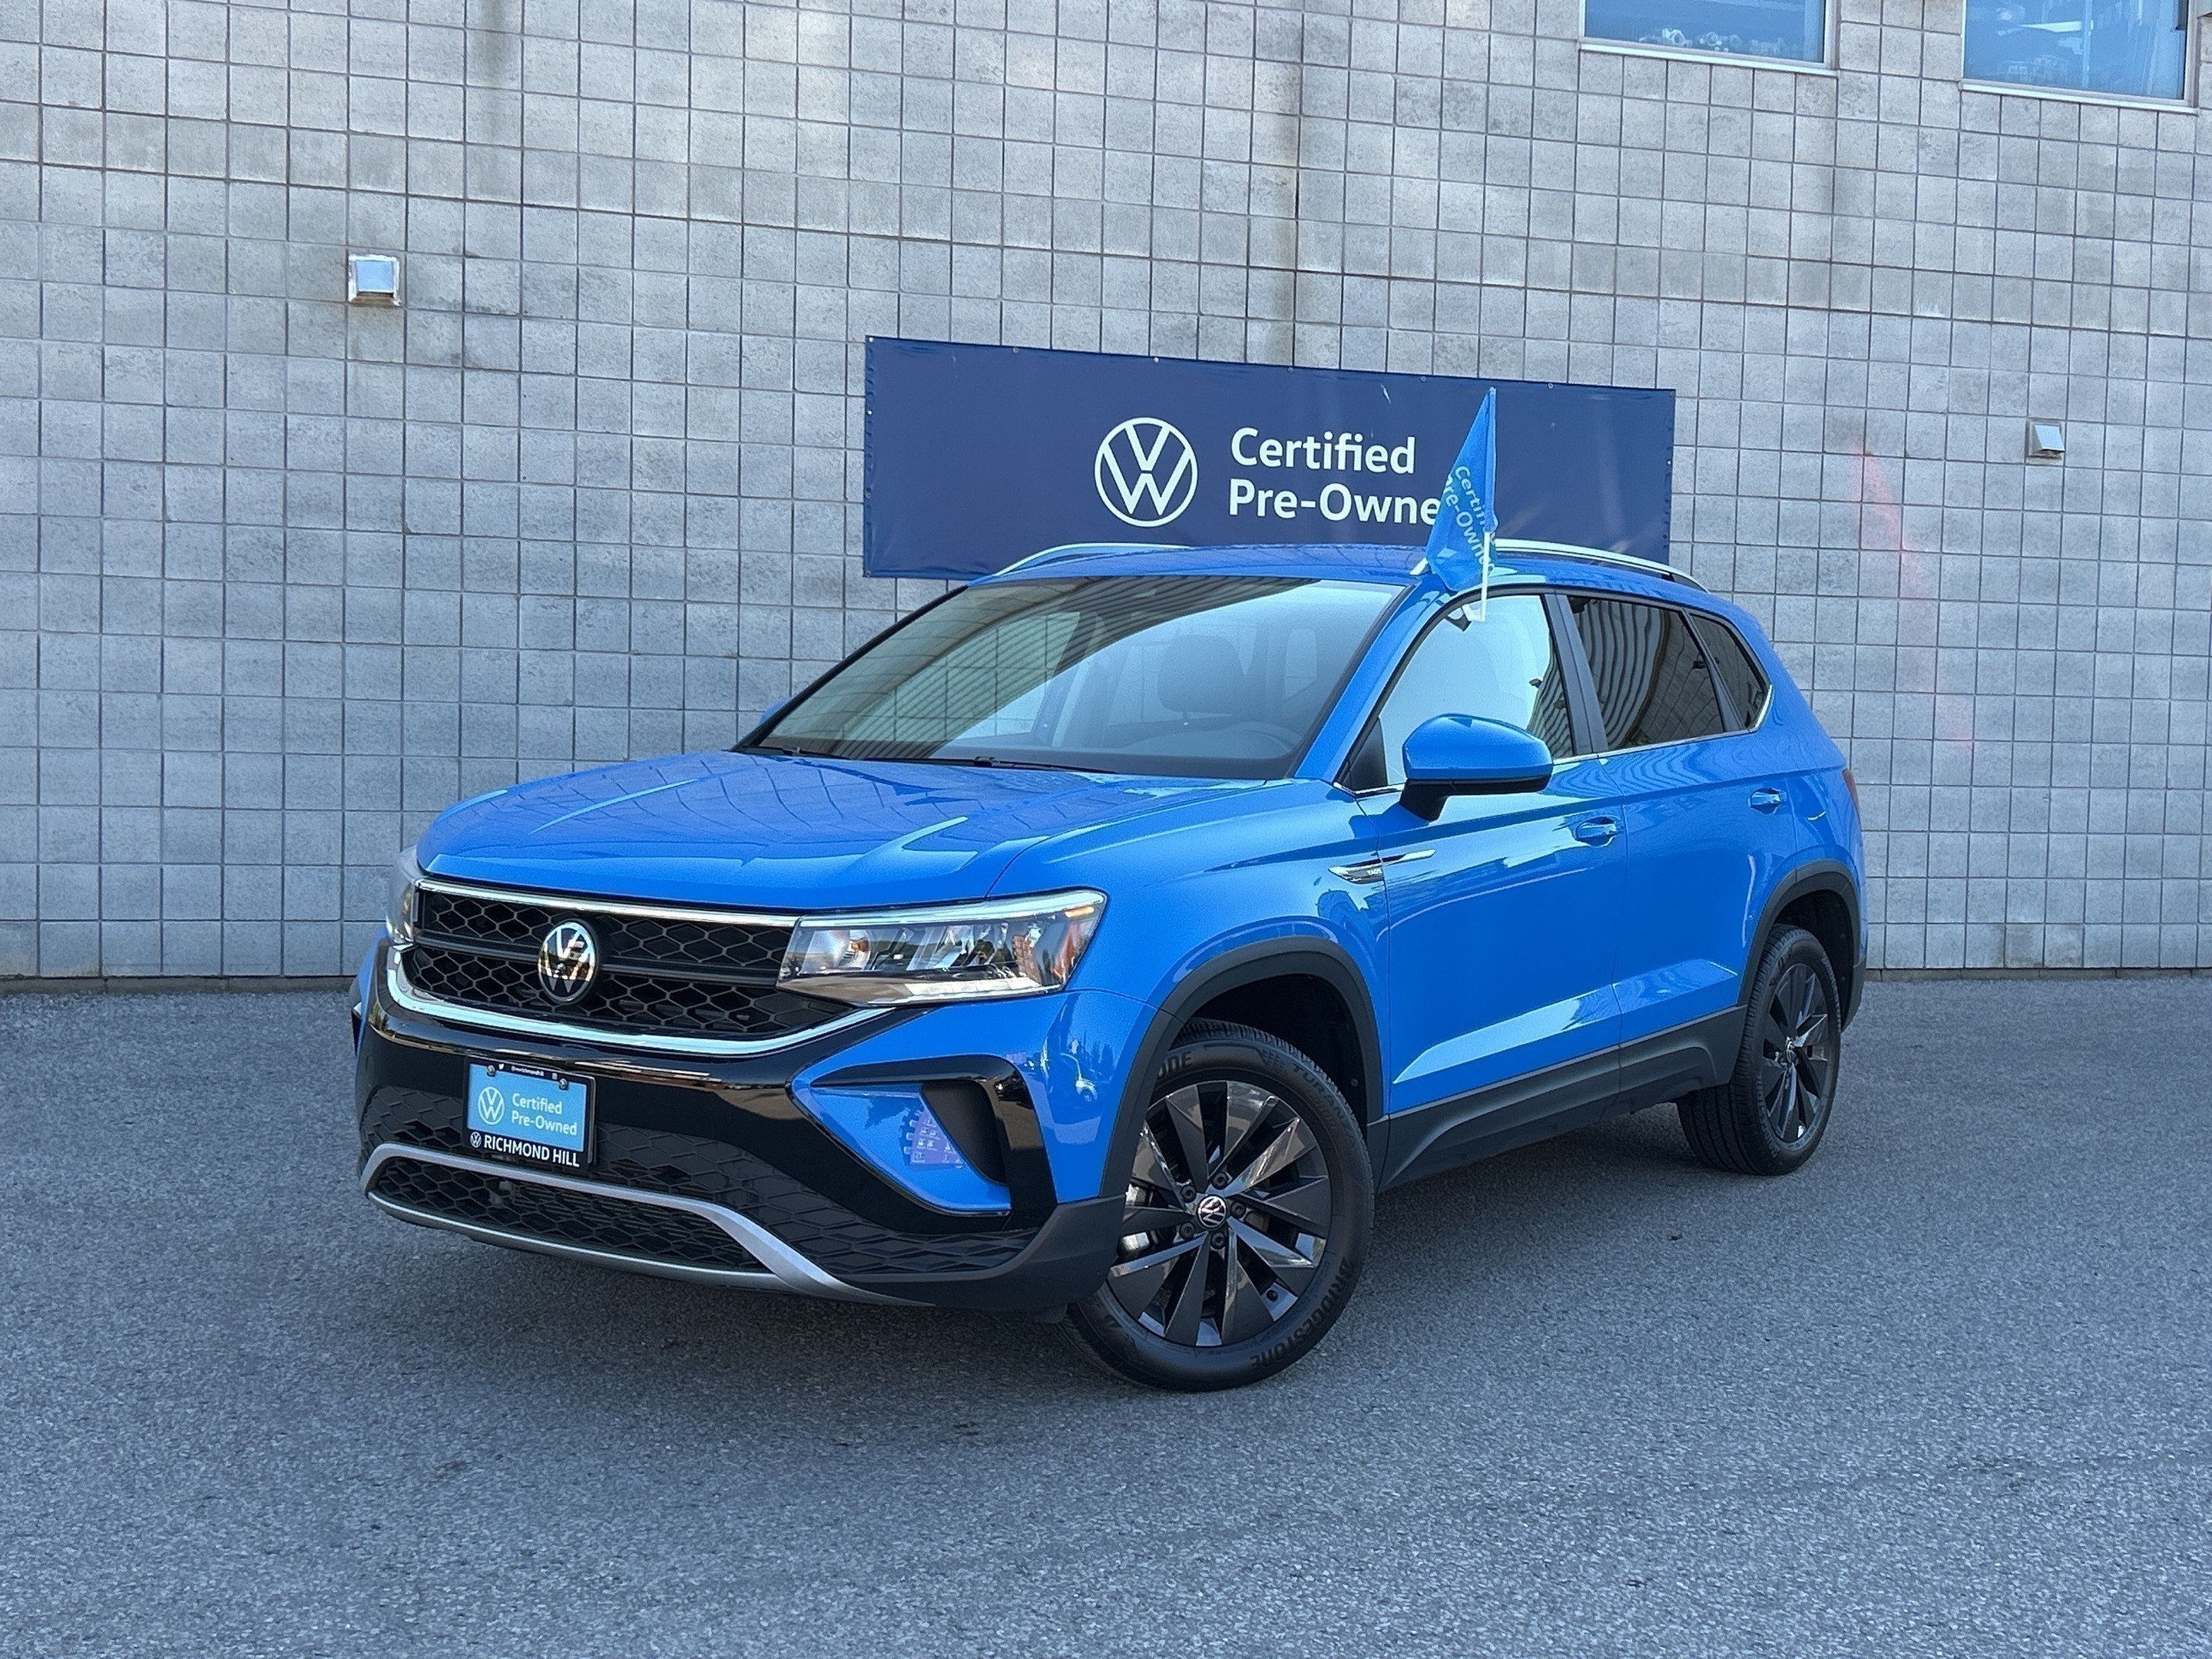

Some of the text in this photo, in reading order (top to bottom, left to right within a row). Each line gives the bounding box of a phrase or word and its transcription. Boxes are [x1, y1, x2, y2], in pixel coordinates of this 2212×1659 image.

[1230, 427, 1416, 474] Certified
[1228, 478, 1439, 525] Pre-Owne
[511, 1111, 578, 1136] Pre-Owned
[512, 1093, 562, 1114] Certified
[484, 1134, 550, 1161] RICHMOND
[552, 1148, 580, 1167] HILL
[1250, 1257, 1354, 1368] BRIDGESTONE
